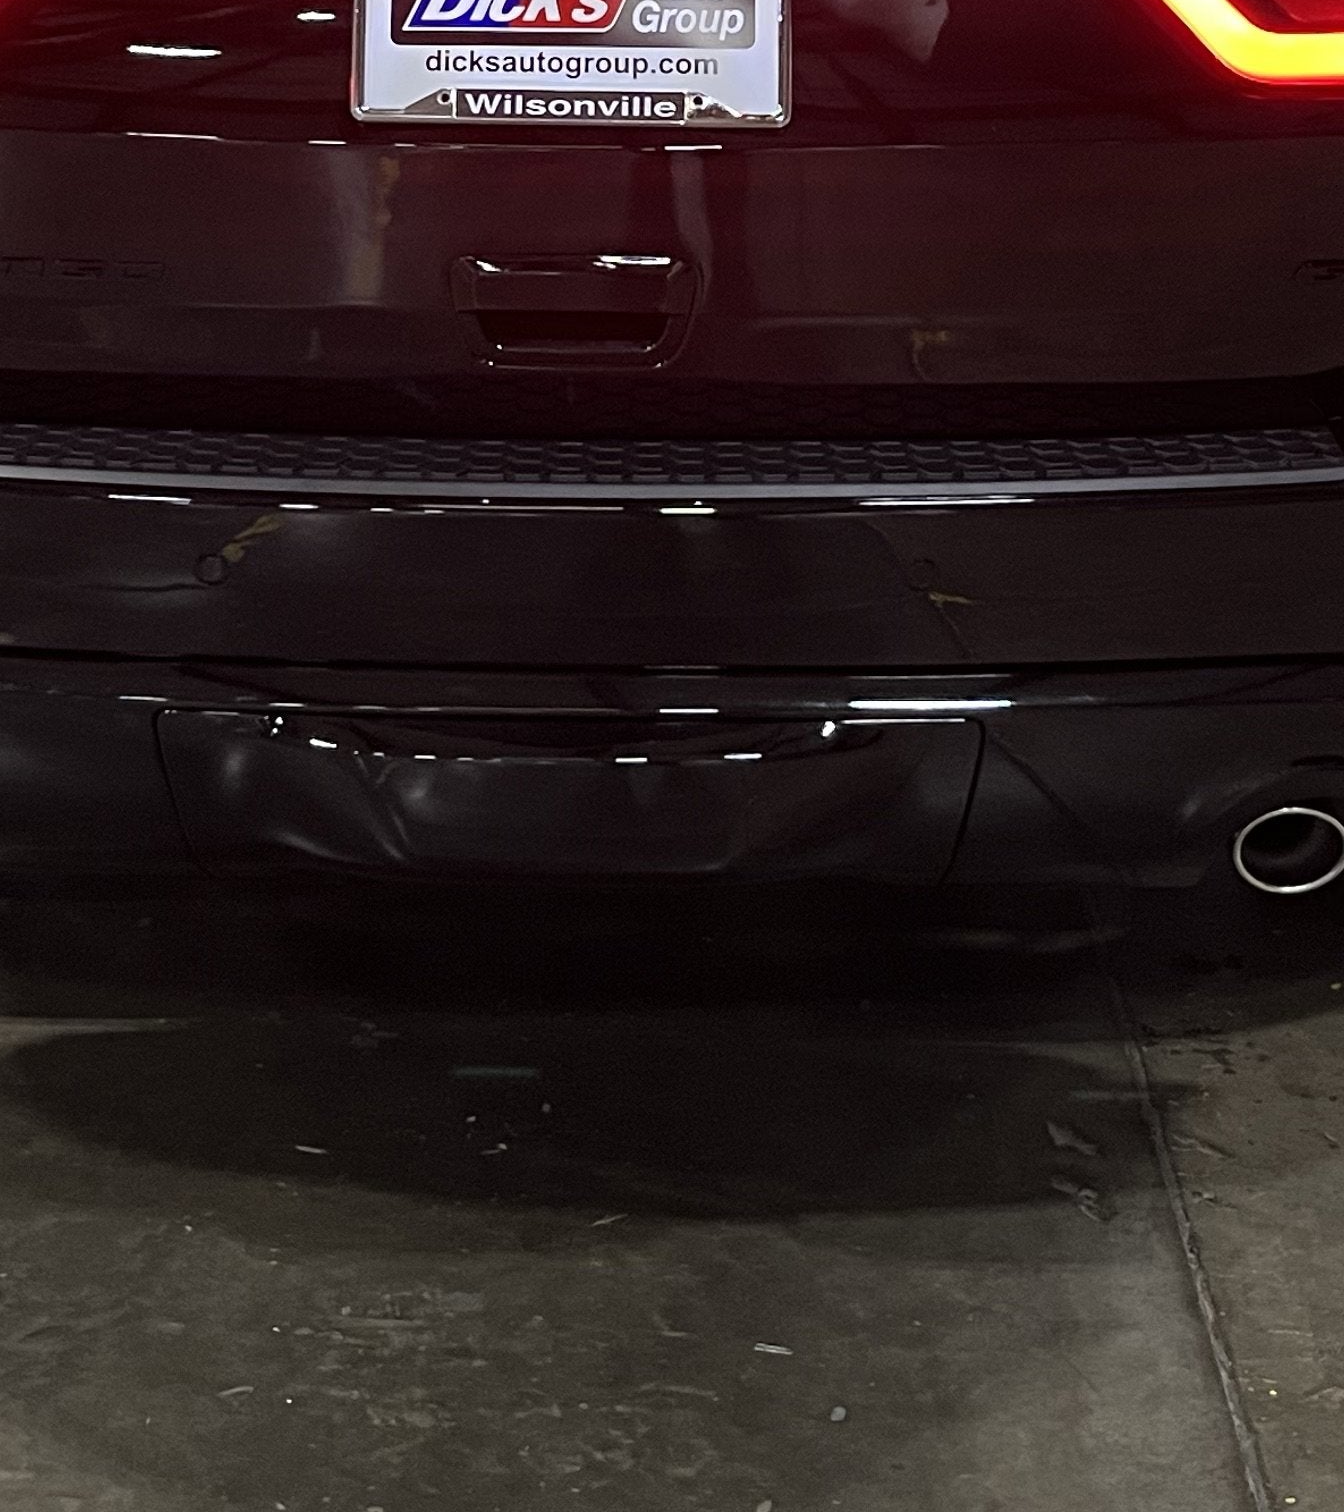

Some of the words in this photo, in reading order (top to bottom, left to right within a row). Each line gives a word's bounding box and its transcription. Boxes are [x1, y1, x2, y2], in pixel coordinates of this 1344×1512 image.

[632, 1, 745, 40] Group
[426, 50, 719, 77] dicksautogroup.com
[465, 92, 677, 118] Wilsonville
